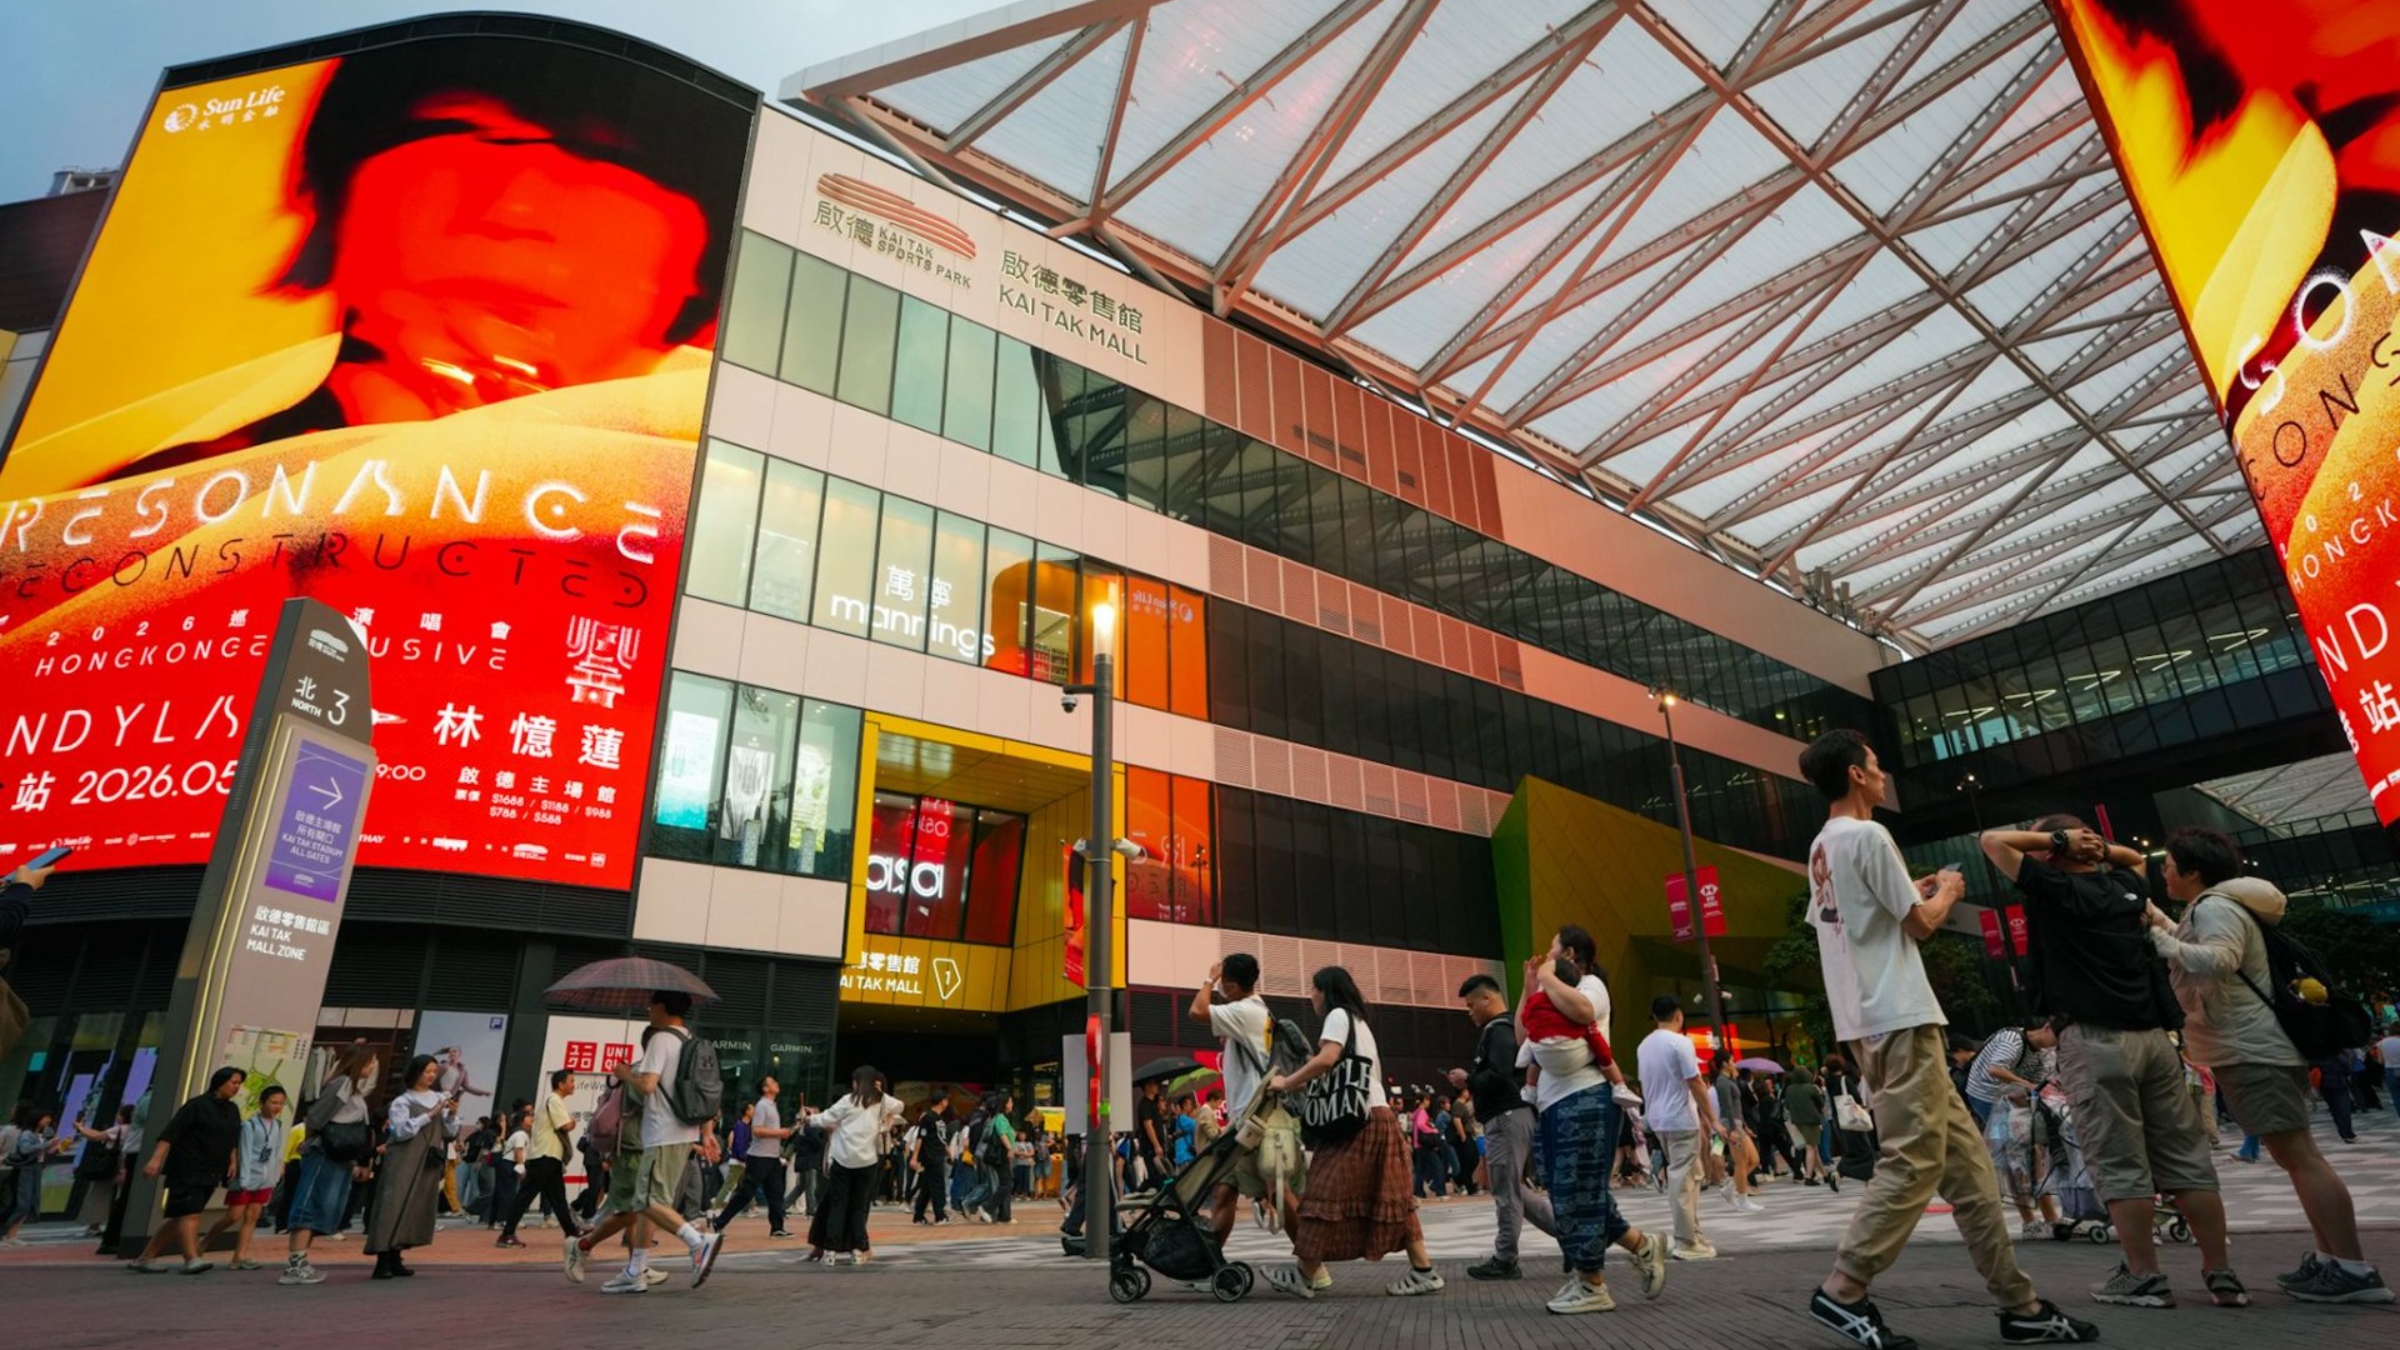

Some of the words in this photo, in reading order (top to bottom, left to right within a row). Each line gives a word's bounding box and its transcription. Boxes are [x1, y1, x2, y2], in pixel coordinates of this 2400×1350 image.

[203, 98, 243, 116] Sun
[245, 85, 286, 108] Life
[879, 226, 903, 246] KAI
[907, 238, 935, 259] TAK
[877, 240, 932, 272] SPORTS
[935, 264, 971, 289] PARK
[999, 283, 1036, 316] KAI
[1040, 301, 1084, 338] TAK
[1089, 323, 1148, 366] MALL
[830, 594, 996, 659] mannings
[295, 676, 317, 700] 北
[291, 698, 322, 717] NORTH
[327, 689, 350, 726] 3
[433, 702, 625, 770] 林憶蓮
[282, 833, 296, 844] KAI
[297, 837, 311, 848] TAK
[311, 841, 343, 857] STADIUM
[290, 846, 305, 857] ALL
[306, 850, 331, 865] GATES
[250, 922, 270, 938] KAI
[271, 927, 292, 943] TAK
[246, 938, 275, 956] MALL
[276, 944, 307, 961] ZONE
[856, 976, 883, 991] TAK
[885, 979, 922, 995] MALL
[945, 970, 951, 986] 1
[606, 1046, 629, 1059] UNI
[769, 1043, 812, 1053] GARMIN
[1304, 1088, 1371, 1126] OMAN
